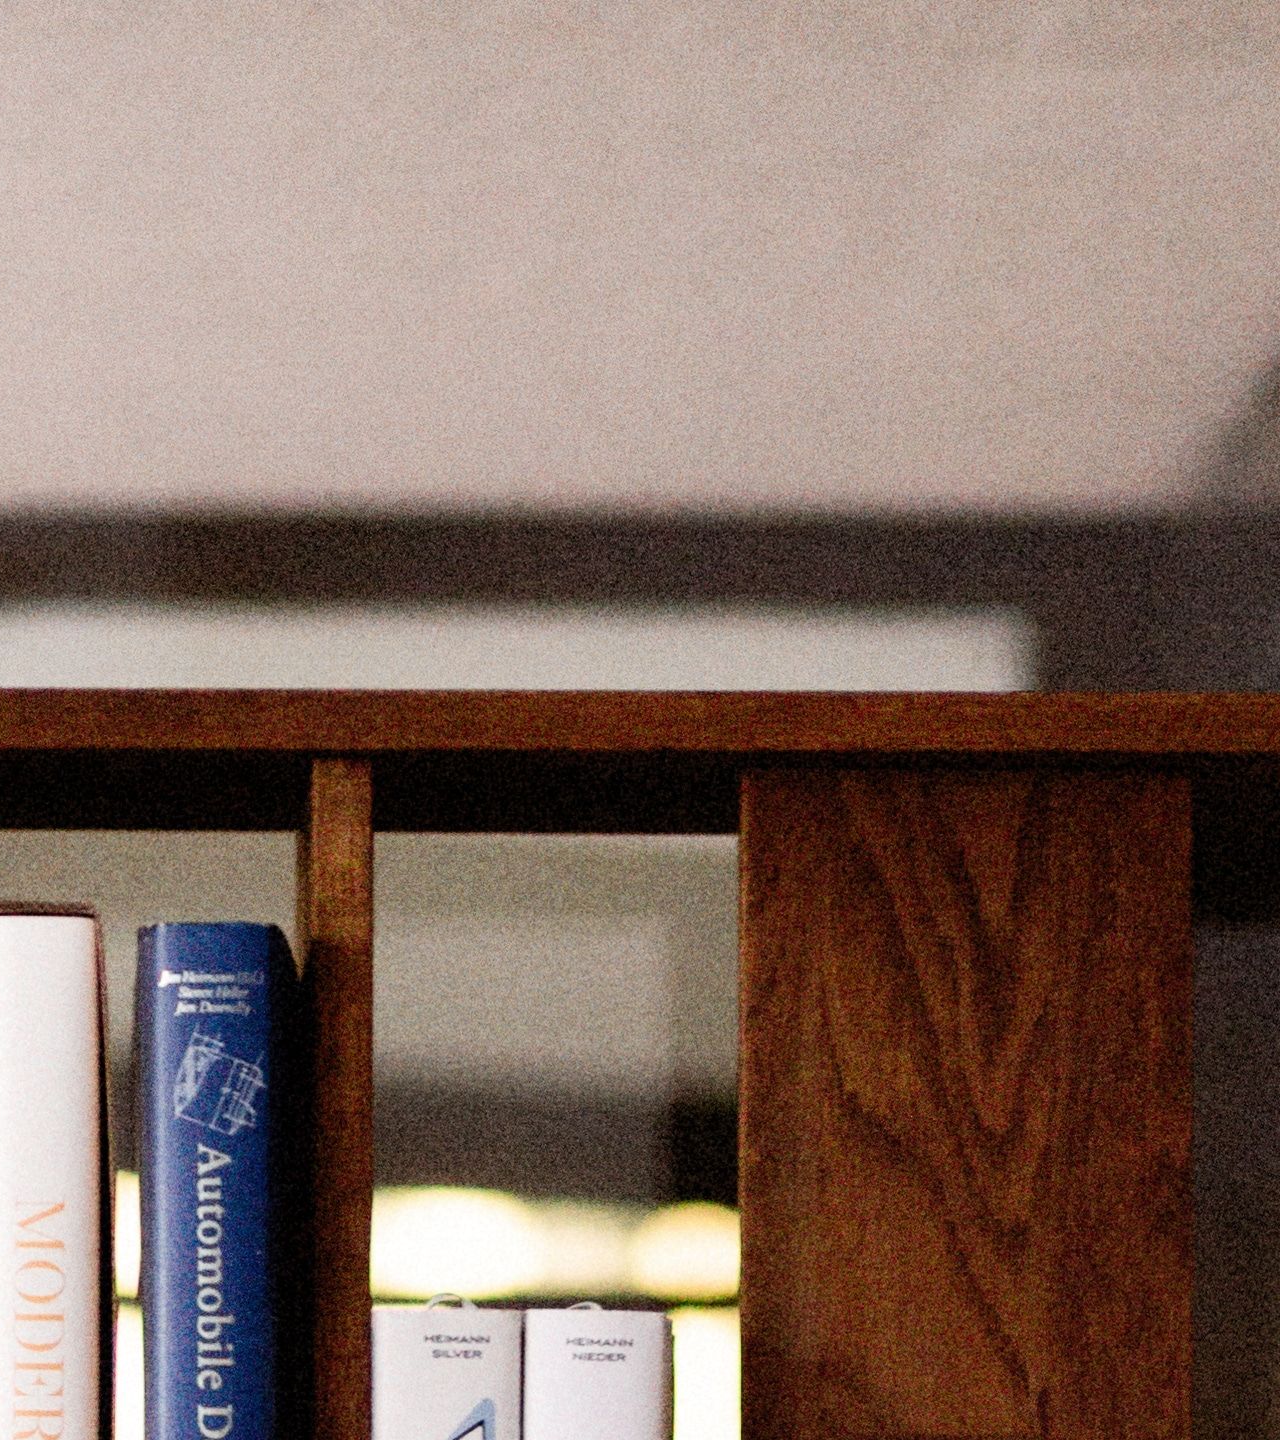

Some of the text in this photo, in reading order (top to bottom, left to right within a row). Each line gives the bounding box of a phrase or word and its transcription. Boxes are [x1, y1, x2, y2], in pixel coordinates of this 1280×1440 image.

[195, 1144, 235, 1398] Automobile
[423, 1334, 491, 1345] HEIMANN
[565, 1337, 634, 1348] HEIMANN
[431, 1348, 484, 1360] SILVER
[571, 1351, 627, 1363] NIEDER
